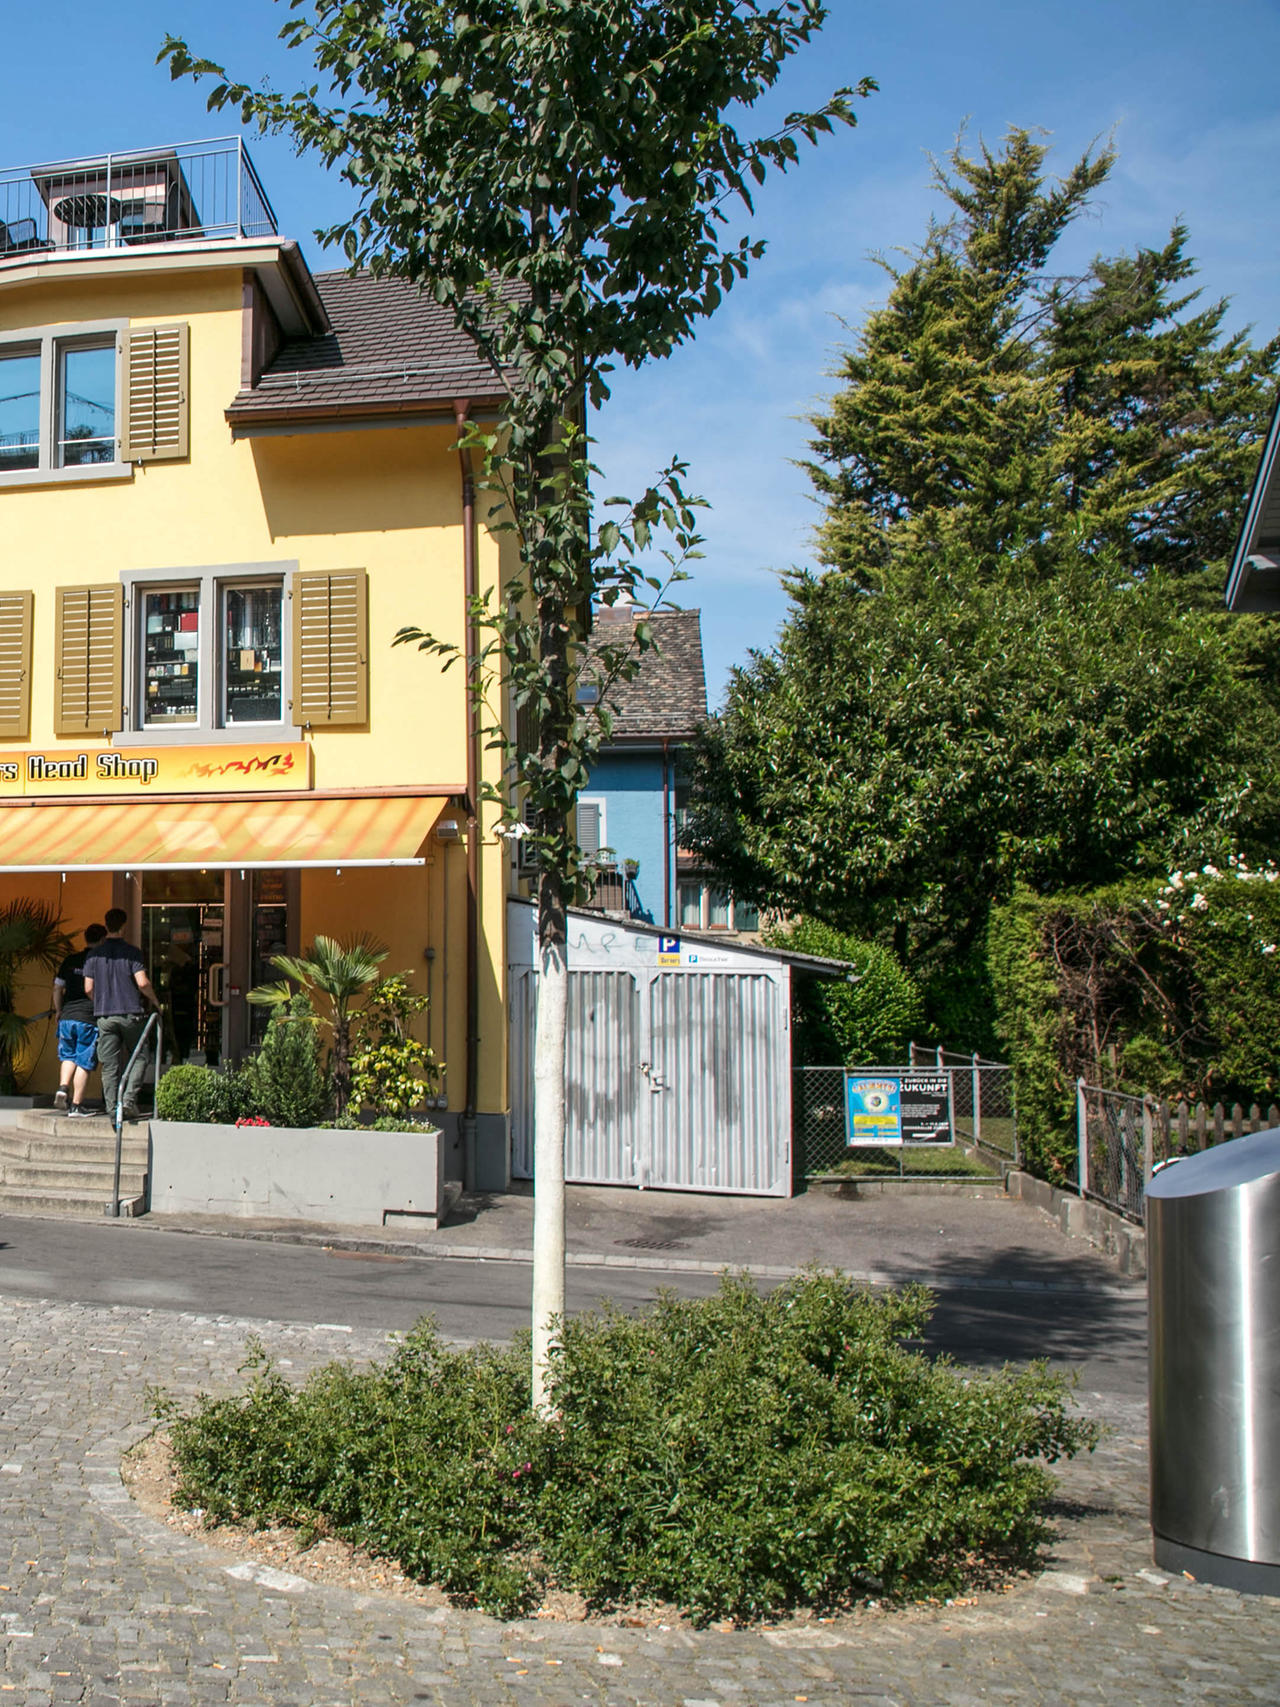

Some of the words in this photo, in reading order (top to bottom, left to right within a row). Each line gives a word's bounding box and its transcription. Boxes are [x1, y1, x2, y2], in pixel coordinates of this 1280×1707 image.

[28, 754, 88, 781] Head
[97, 753, 158, 785] Shop
[663, 937, 676, 952] P
